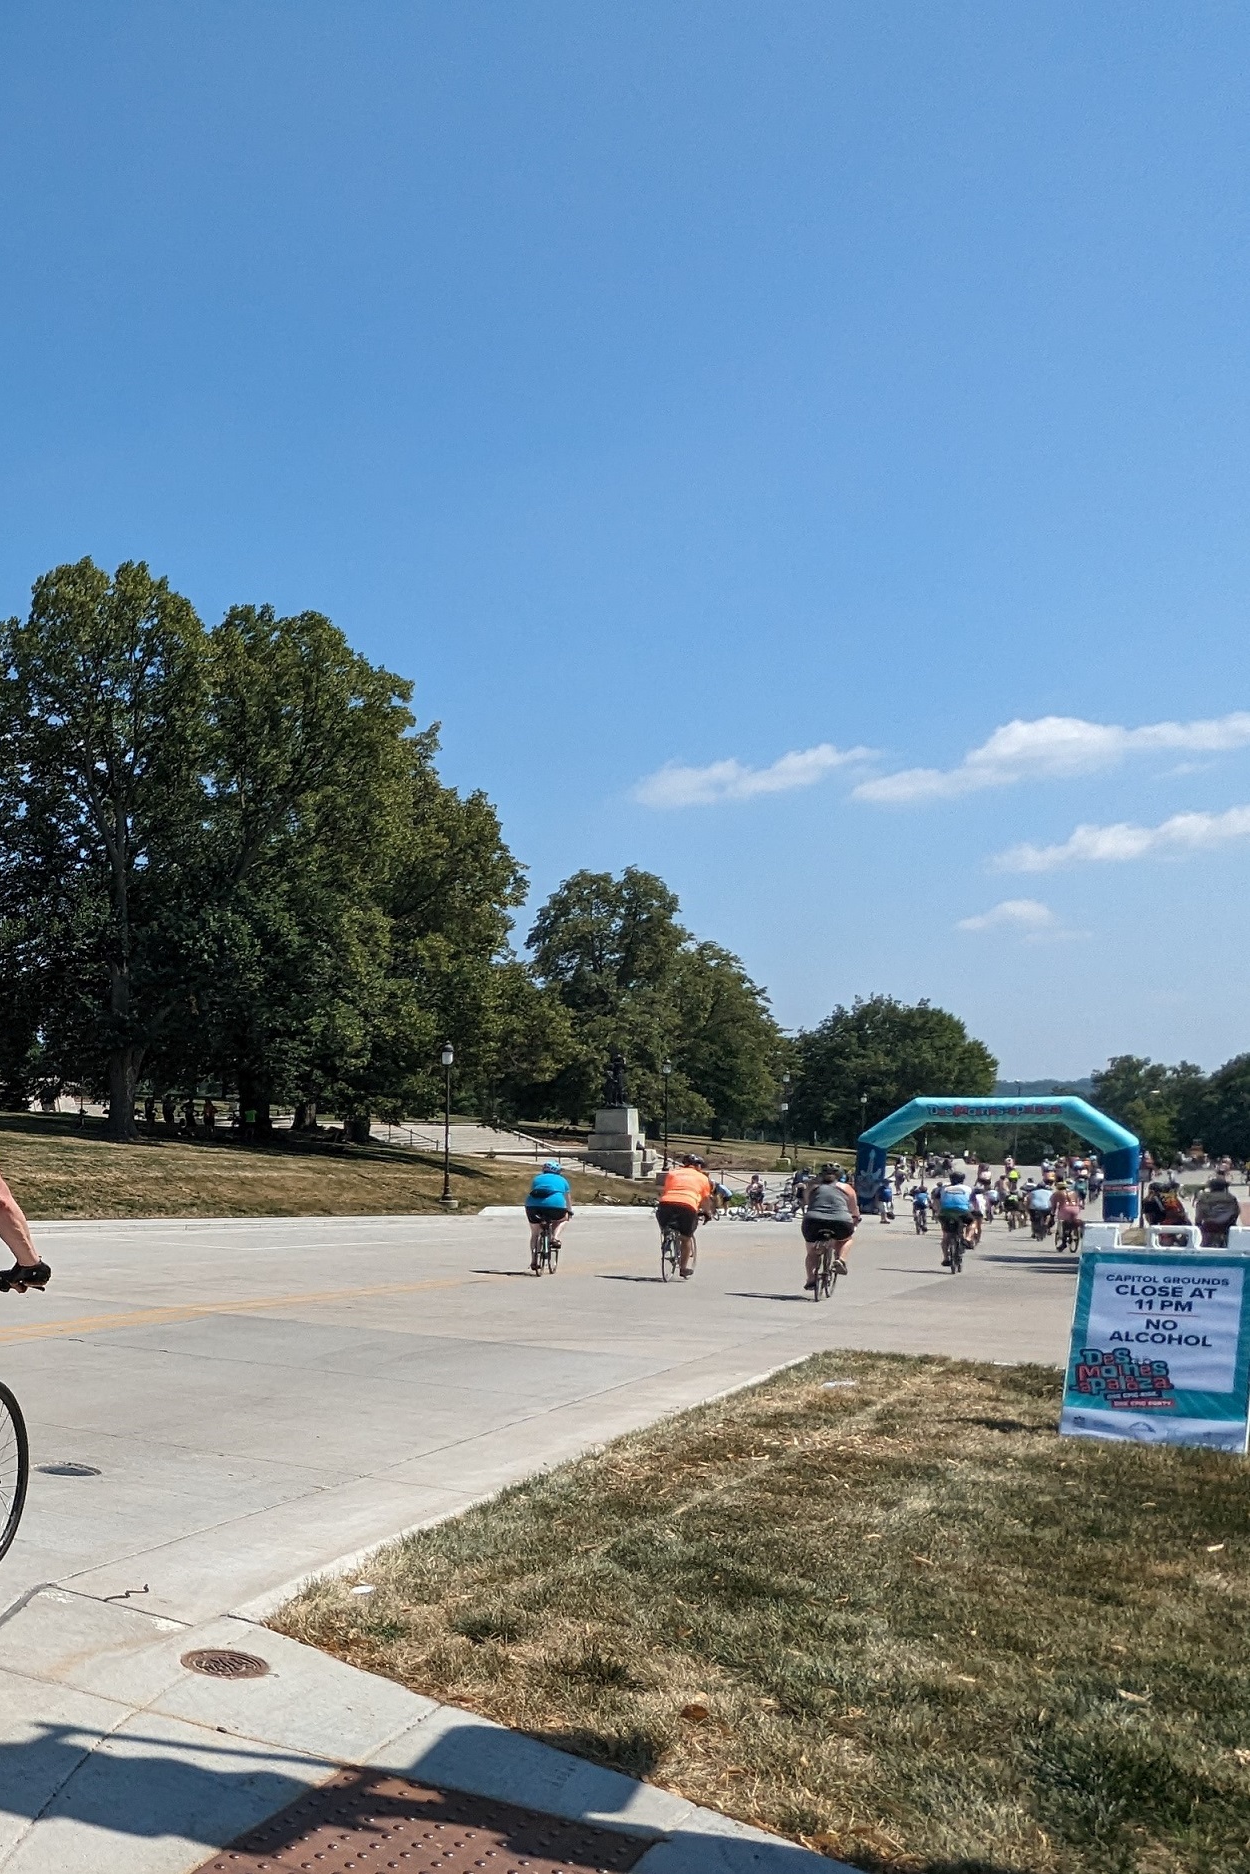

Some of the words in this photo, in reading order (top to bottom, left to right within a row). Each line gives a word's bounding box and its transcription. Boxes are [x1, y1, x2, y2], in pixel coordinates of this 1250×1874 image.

[1106, 1274, 1159, 1284] CAPITOL
[1162, 1276, 1230, 1286] GROUNDS
[1115, 1284, 1183, 1298] CLOSE
[1189, 1287, 1218, 1299] AT
[1135, 1299, 1154, 1311] 11
[1160, 1300, 1193, 1312] PM
[1145, 1318, 1178, 1331] NO
[1109, 1330, 1213, 1348] ALCOHOL
